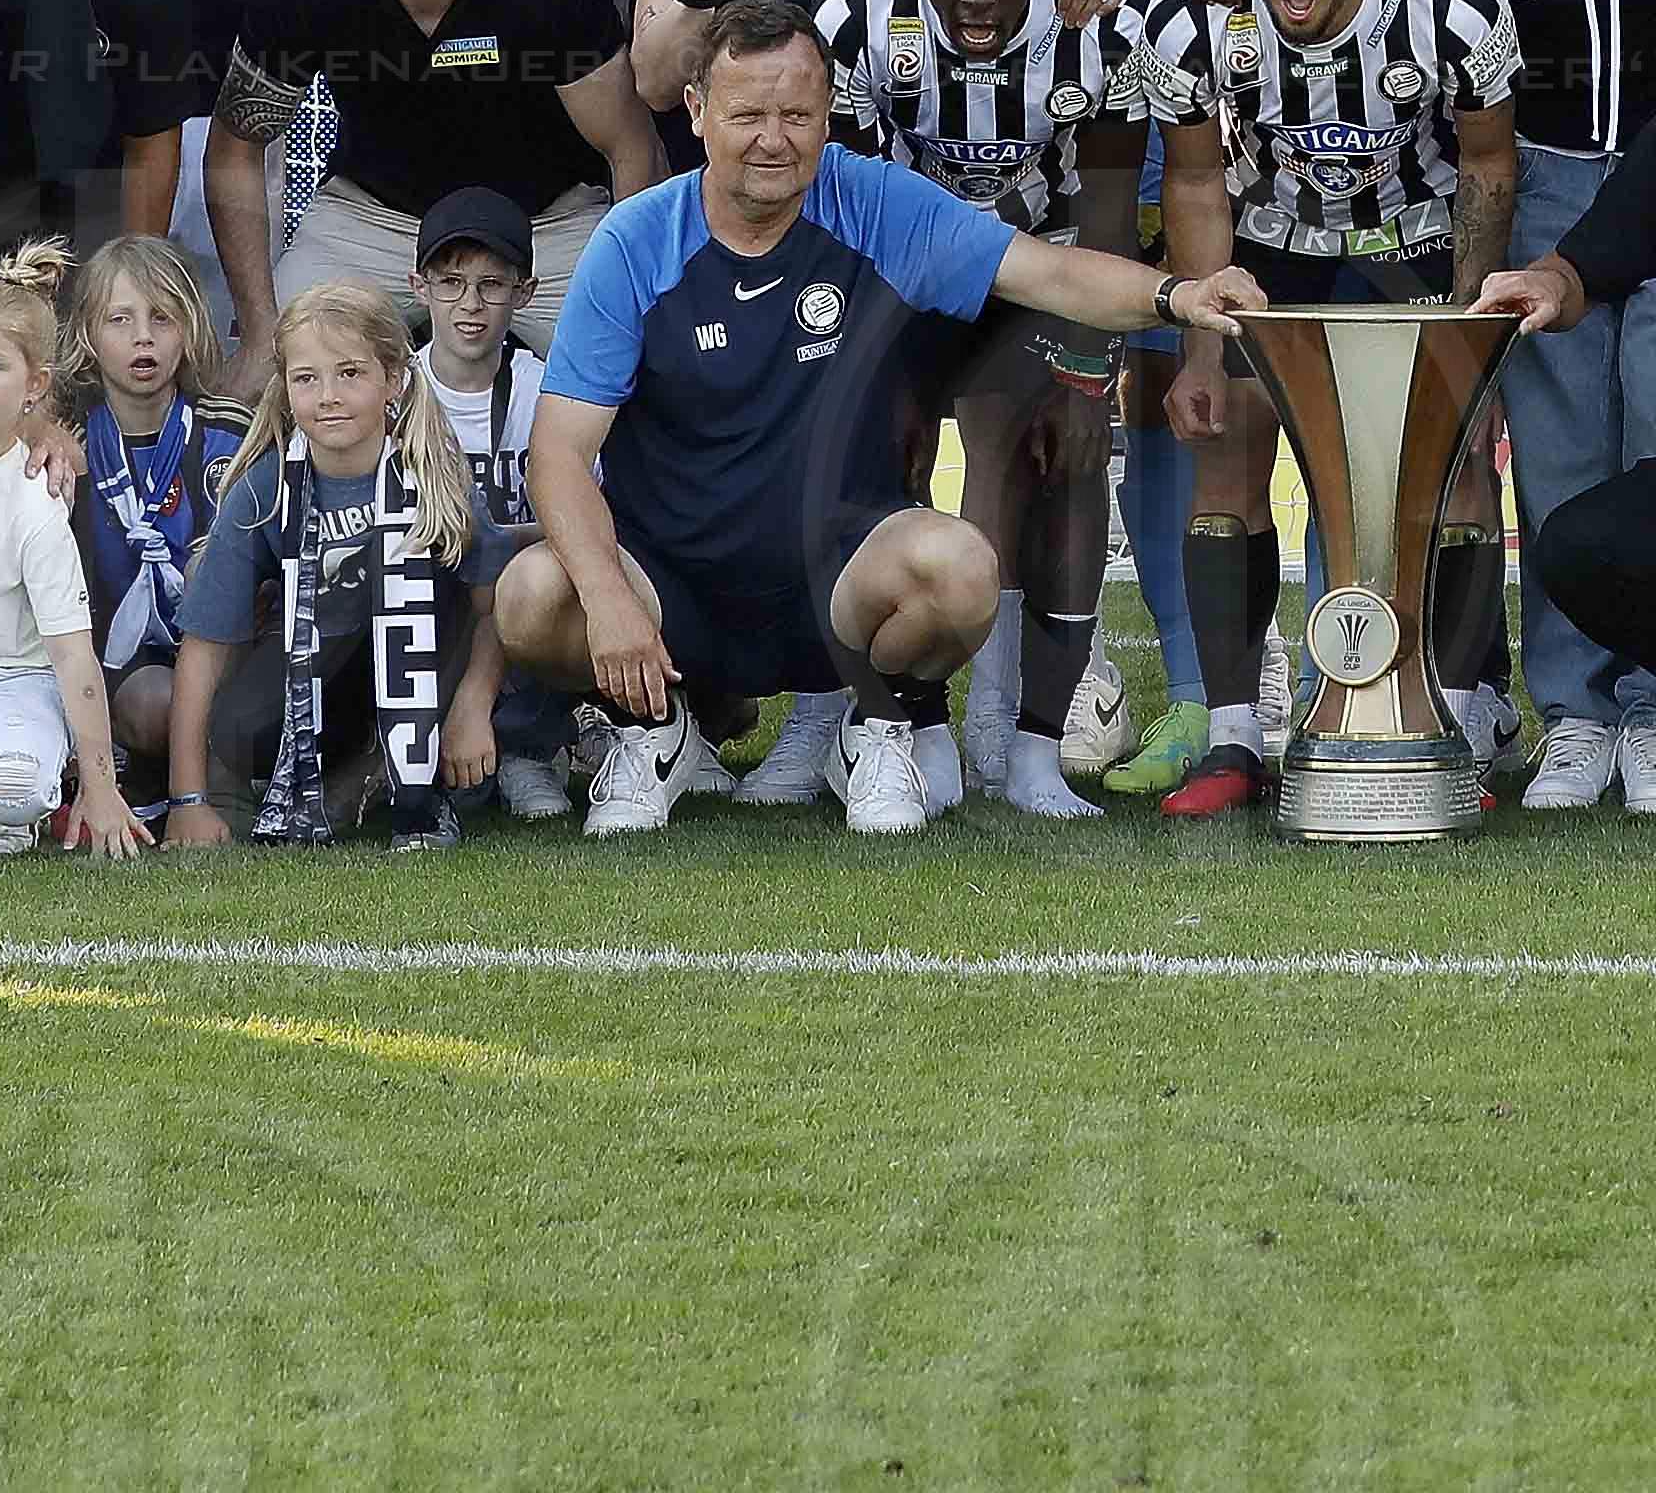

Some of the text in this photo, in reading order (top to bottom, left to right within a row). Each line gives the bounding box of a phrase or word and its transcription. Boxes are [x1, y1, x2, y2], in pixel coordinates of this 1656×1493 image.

[433, 49, 500, 68] ADMIRAL
[965, 70, 1010, 86] GRAWE
[1306, 62, 1350, 79] GRAWE
[1237, 199, 1454, 258] GRAZ
[695, 322, 728, 352] WG
